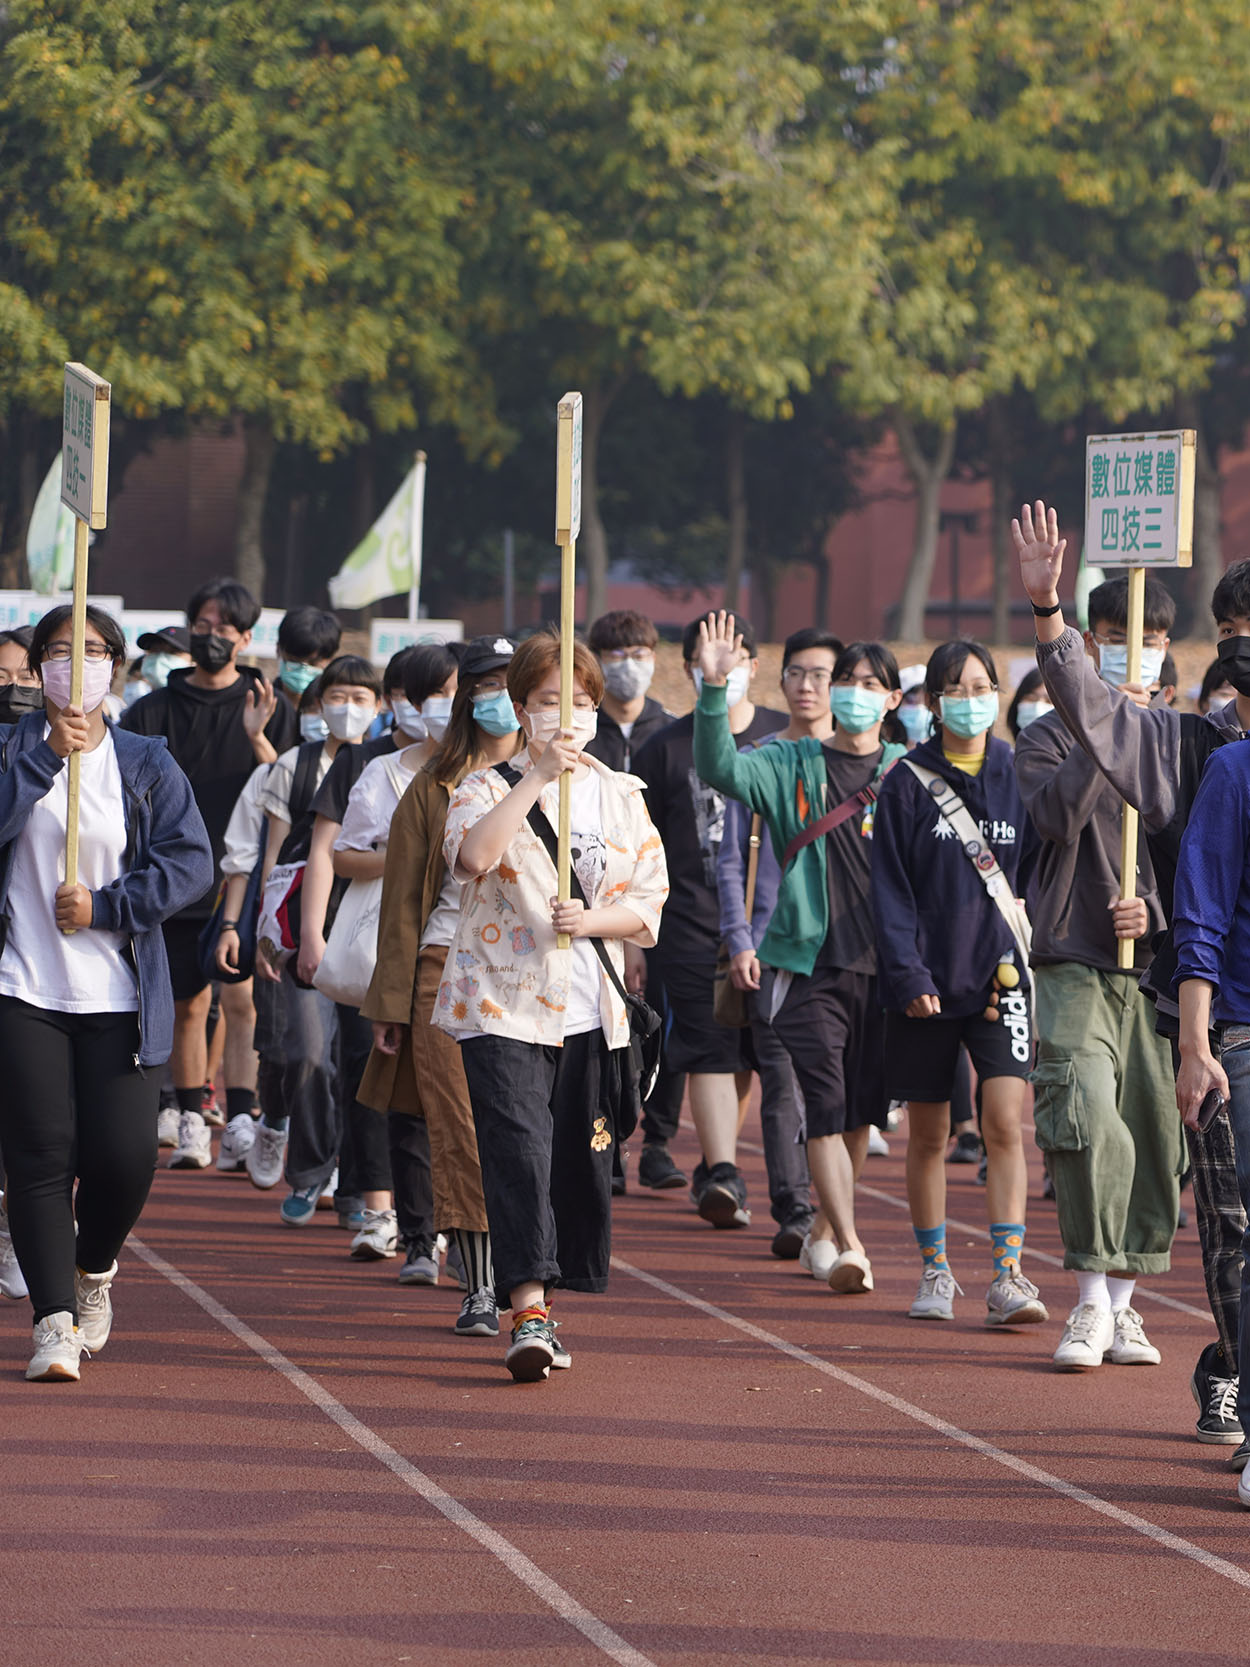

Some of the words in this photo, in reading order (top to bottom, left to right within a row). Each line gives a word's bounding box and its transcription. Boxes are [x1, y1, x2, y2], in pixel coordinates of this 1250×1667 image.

[1091, 449, 1176, 499] 數位媒體
[1101, 505, 1162, 552] 四技三
[1000, 988, 1030, 1063] adid
